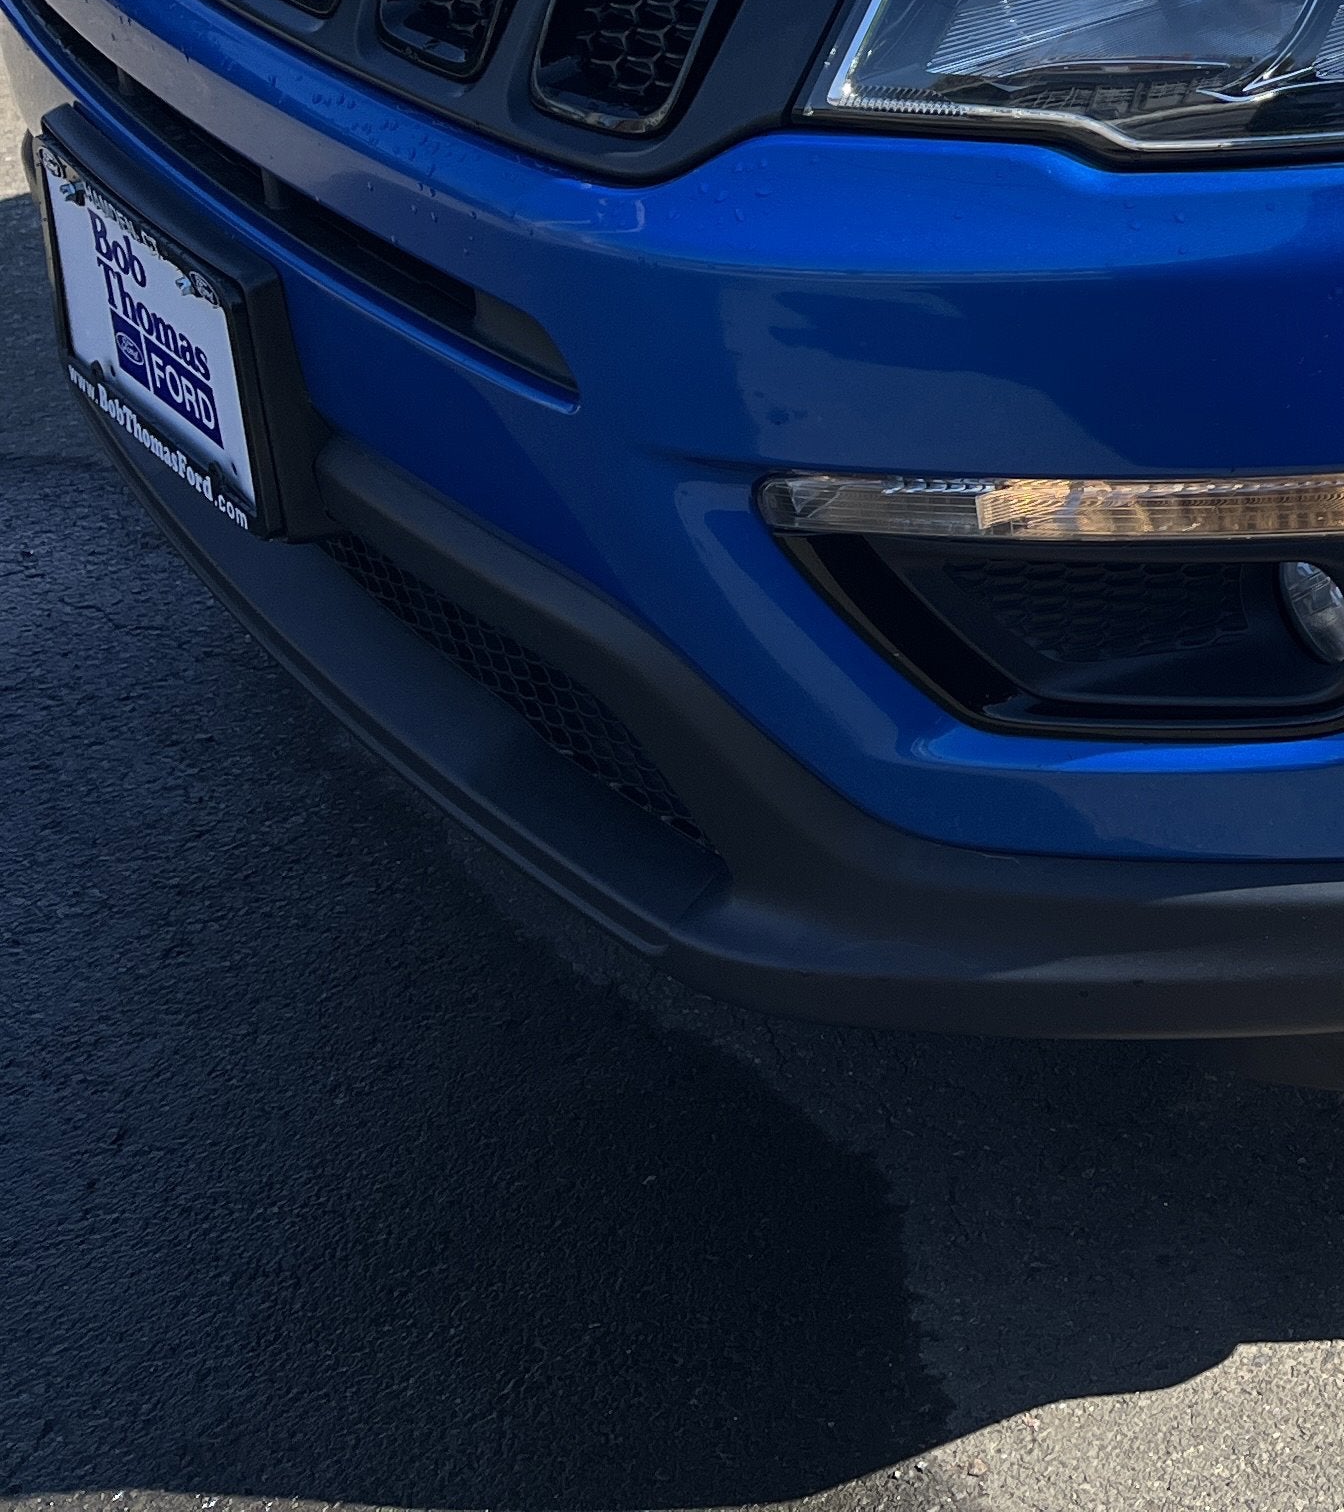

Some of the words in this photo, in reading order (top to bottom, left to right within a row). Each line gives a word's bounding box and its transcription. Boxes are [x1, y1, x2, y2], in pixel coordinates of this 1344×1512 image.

[89, 208, 146, 289] Bob
[96, 256, 211, 382] Thomas
[154, 356, 216, 432] FORD
[68, 364, 249, 530] www.BobThomasFord.com
